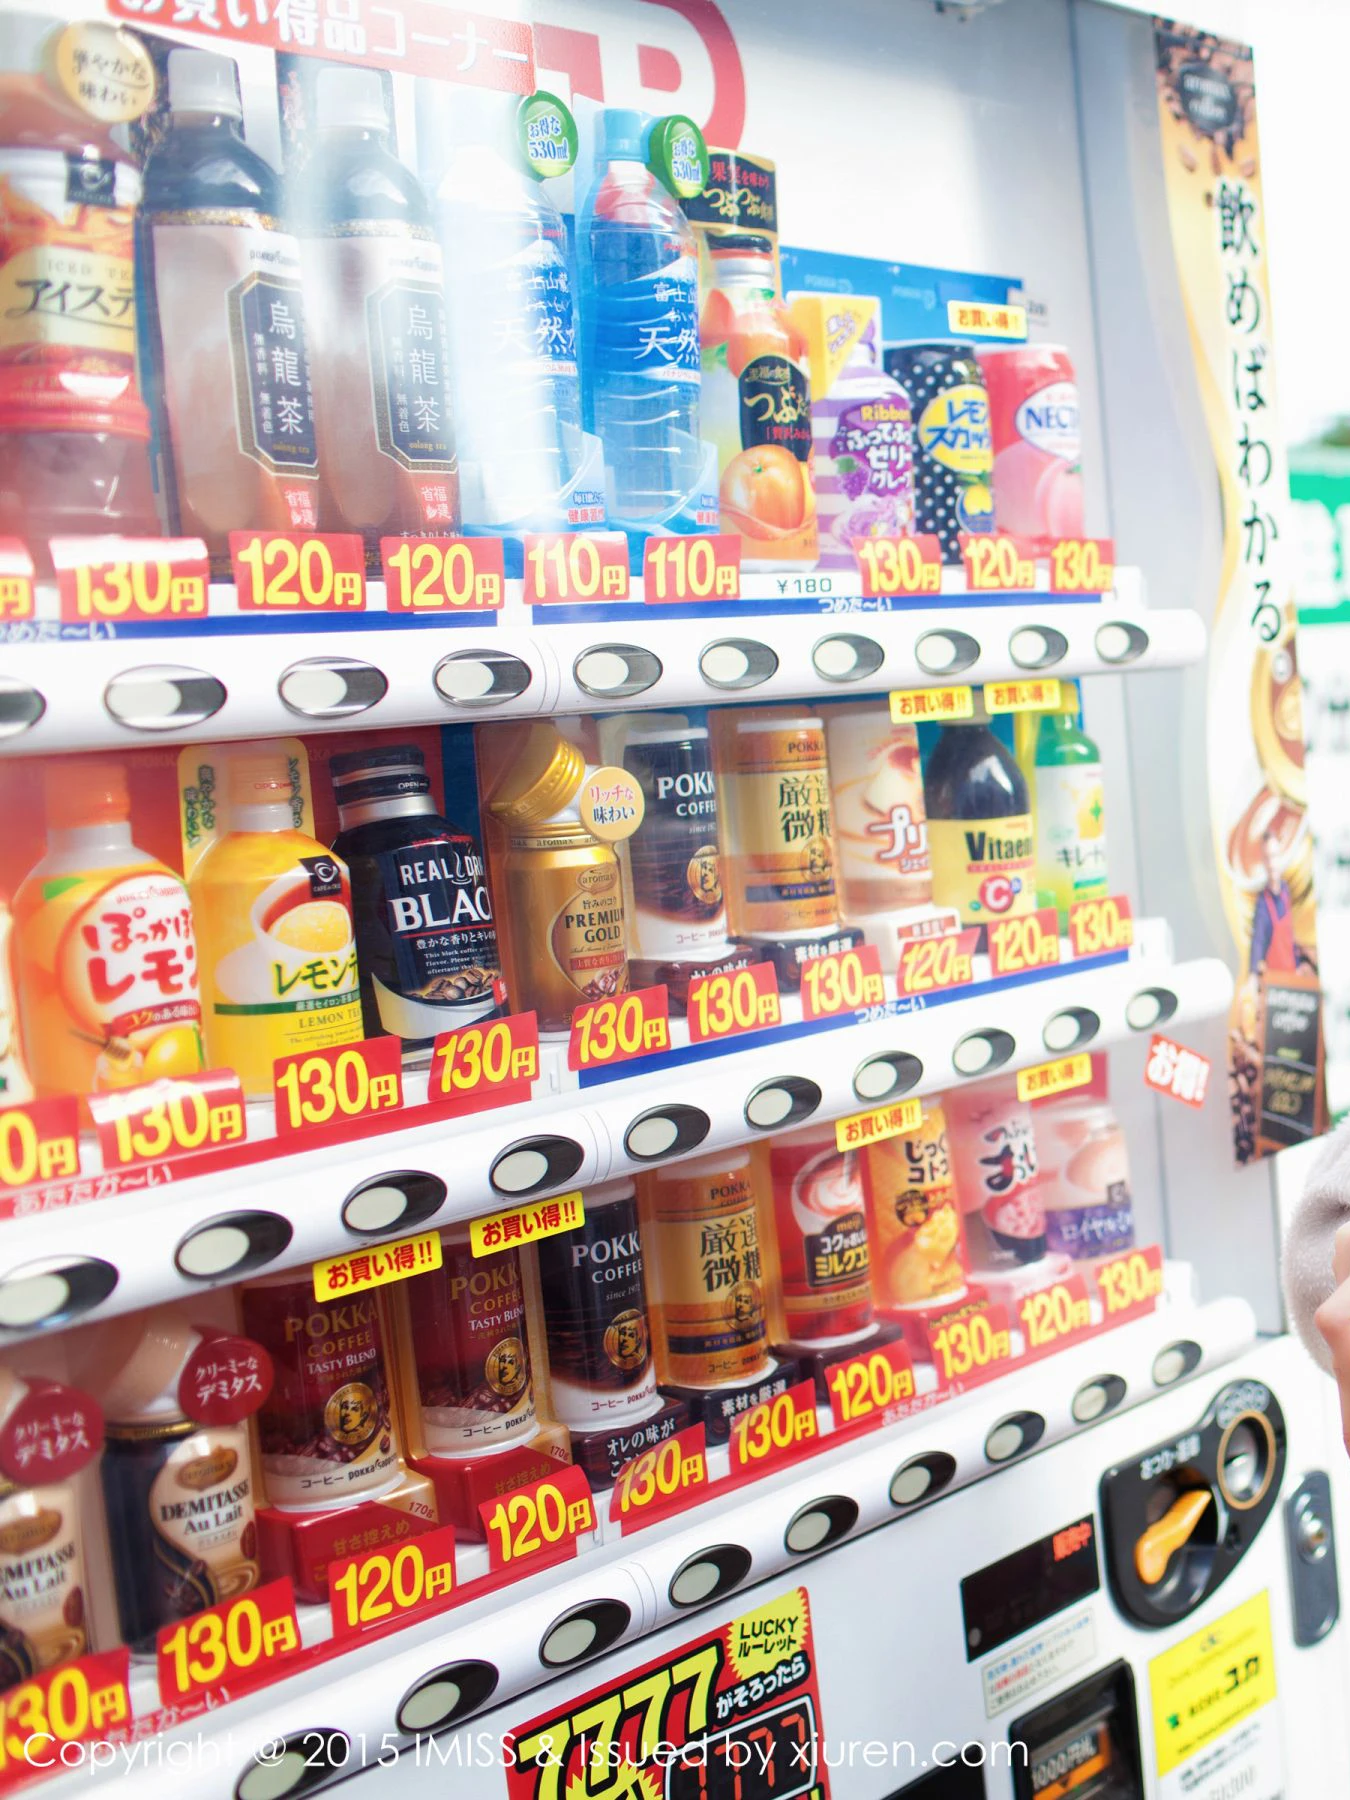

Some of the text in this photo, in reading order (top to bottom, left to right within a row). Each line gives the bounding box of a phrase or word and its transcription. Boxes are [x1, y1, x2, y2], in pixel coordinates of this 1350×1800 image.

[123, 0, 528, 72] 買い得品コーナー
[269, 301, 303, 436] 烏龍茶
[407, 304, 441, 433] 烏龍茶
[1217, 178, 1282, 645] 飲めばわかる
[72, 558, 205, 616] 130円
[238, 538, 362, 607] 120円
[388, 543, 500, 607] 120円
[528, 538, 626, 598] 110円
[648, 538, 738, 597] 110円
[859, 539, 940, 592] 130円
[966, 538, 1036, 590] 120円
[1052, 541, 1113, 592] 130円
[589, 784, 634, 802] リッチな
[593, 805, 635, 825] 味わい
[536, 837, 573, 847] aromax
[399, 857, 454, 886] REAL
[584, 925, 621, 944] GOLD
[991, 918, 1059, 972] 120円
[1072, 901, 1133, 955] 130円
[804, 955, 883, 1016] 130円
[903, 937, 973, 993] 120円
[298, 1012, 345, 1029] LEMON
[575, 995, 668, 1063] 130円
[692, 971, 778, 1037] 130円
[436, 1022, 536, 1093] 130円
[276, 1050, 398, 1129] 130円
[112, 1082, 243, 1163] 130円
[481, 1200, 577, 1248] お買い得!!
[700, 1214, 758, 1259] 厳選
[327, 1240, 434, 1291] お買い得!!
[1098, 1255, 1163, 1312] 130円
[606, 1288, 626, 1302] since
[1020, 1286, 1090, 1347] 120円
[284, 1301, 379, 1342] POKKA
[306, 1330, 372, 1358] COFFEE
[468, 1314, 502, 1331] TASTY
[194, 1356, 260, 1383] クリーミーな
[306, 1359, 343, 1375] TASTY
[345, 1348, 377, 1367] BLEND
[708, 1360, 738, 1373] コーヒー
[933, 1315, 1010, 1380] 130円
[196, 1372, 263, 1406] デミタス
[592, 1400, 624, 1412] コーヒー
[831, 1352, 915, 1424] 120円
[463, 1424, 502, 1438] コーヒー
[549, 1445, 569, 1461] 170g
[606, 1416, 676, 1457] オレの味が
[734, 1391, 816, 1465] 130円
[301, 1475, 344, 1489] コーヒー
[494, 1464, 553, 1495] 甘さ控えめ
[617, 1439, 704, 1513] 130円
[183, 1505, 243, 1536] Au Lait
[332, 1518, 411, 1554] 甘さ控えめ
[408, 1501, 435, 1520] 170g
[488, 1483, 592, 1563] 120円
[32, 1570, 67, 1593] Lait
[334, 1543, 453, 1627] 120円
[162, 1598, 297, 1693] 130円
[738, 1636, 797, 1658] ルーレット
[739, 1615, 799, 1640] LUCKY
[716, 1655, 806, 1720] がそろったら
